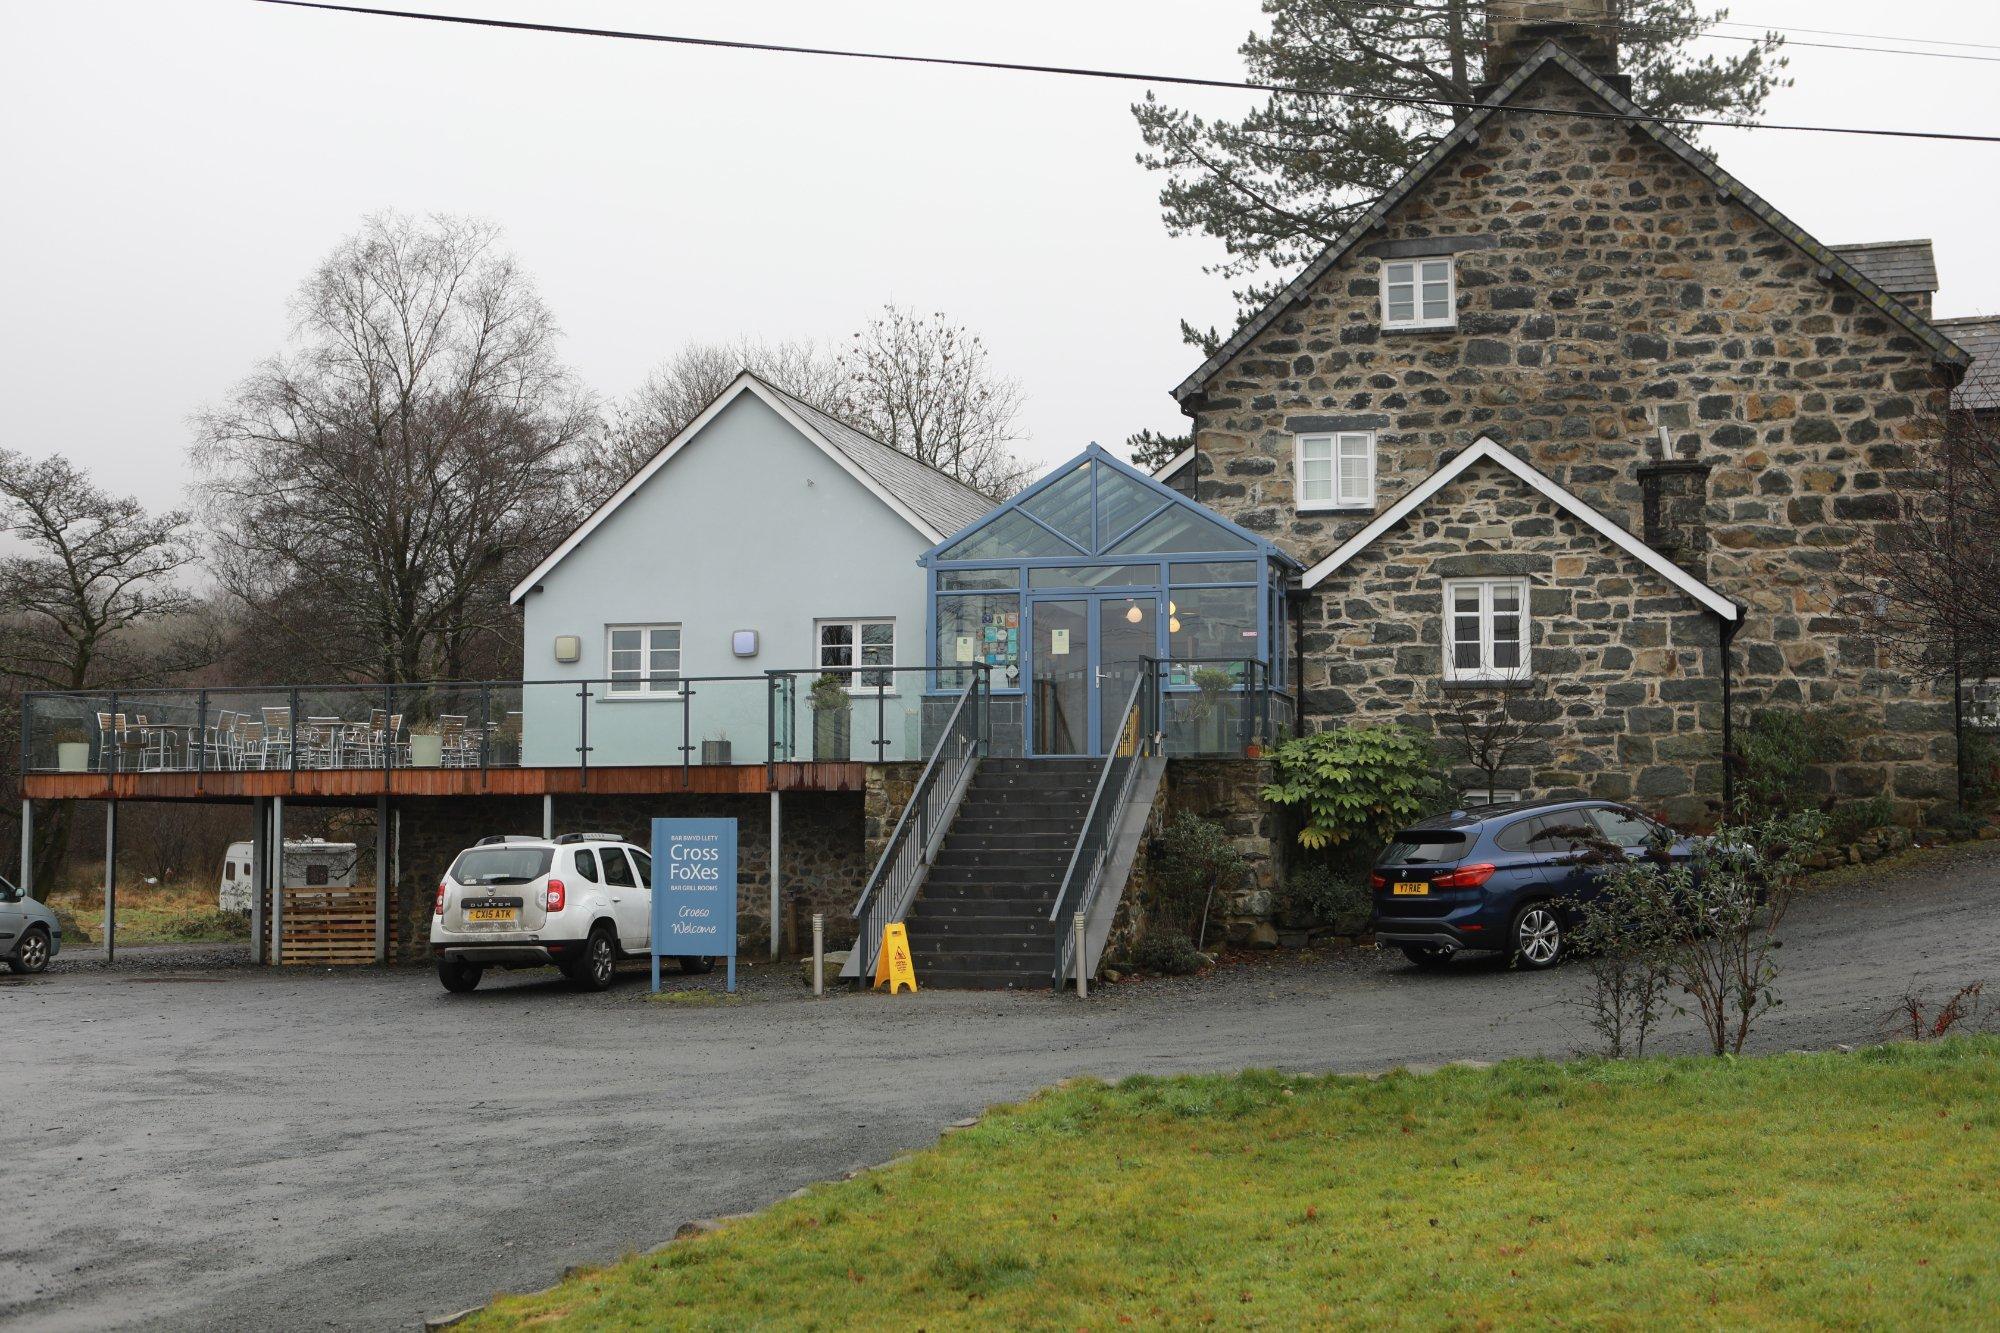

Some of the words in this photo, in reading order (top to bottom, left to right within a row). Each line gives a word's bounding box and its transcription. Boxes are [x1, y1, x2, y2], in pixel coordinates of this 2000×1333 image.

[670, 844, 718, 861] Cross
[670, 863, 718, 880] FoXes
[495, 910, 511, 918] ATK
[679, 905, 710, 918] Croeso
[671, 921, 717, 934] Welcome
